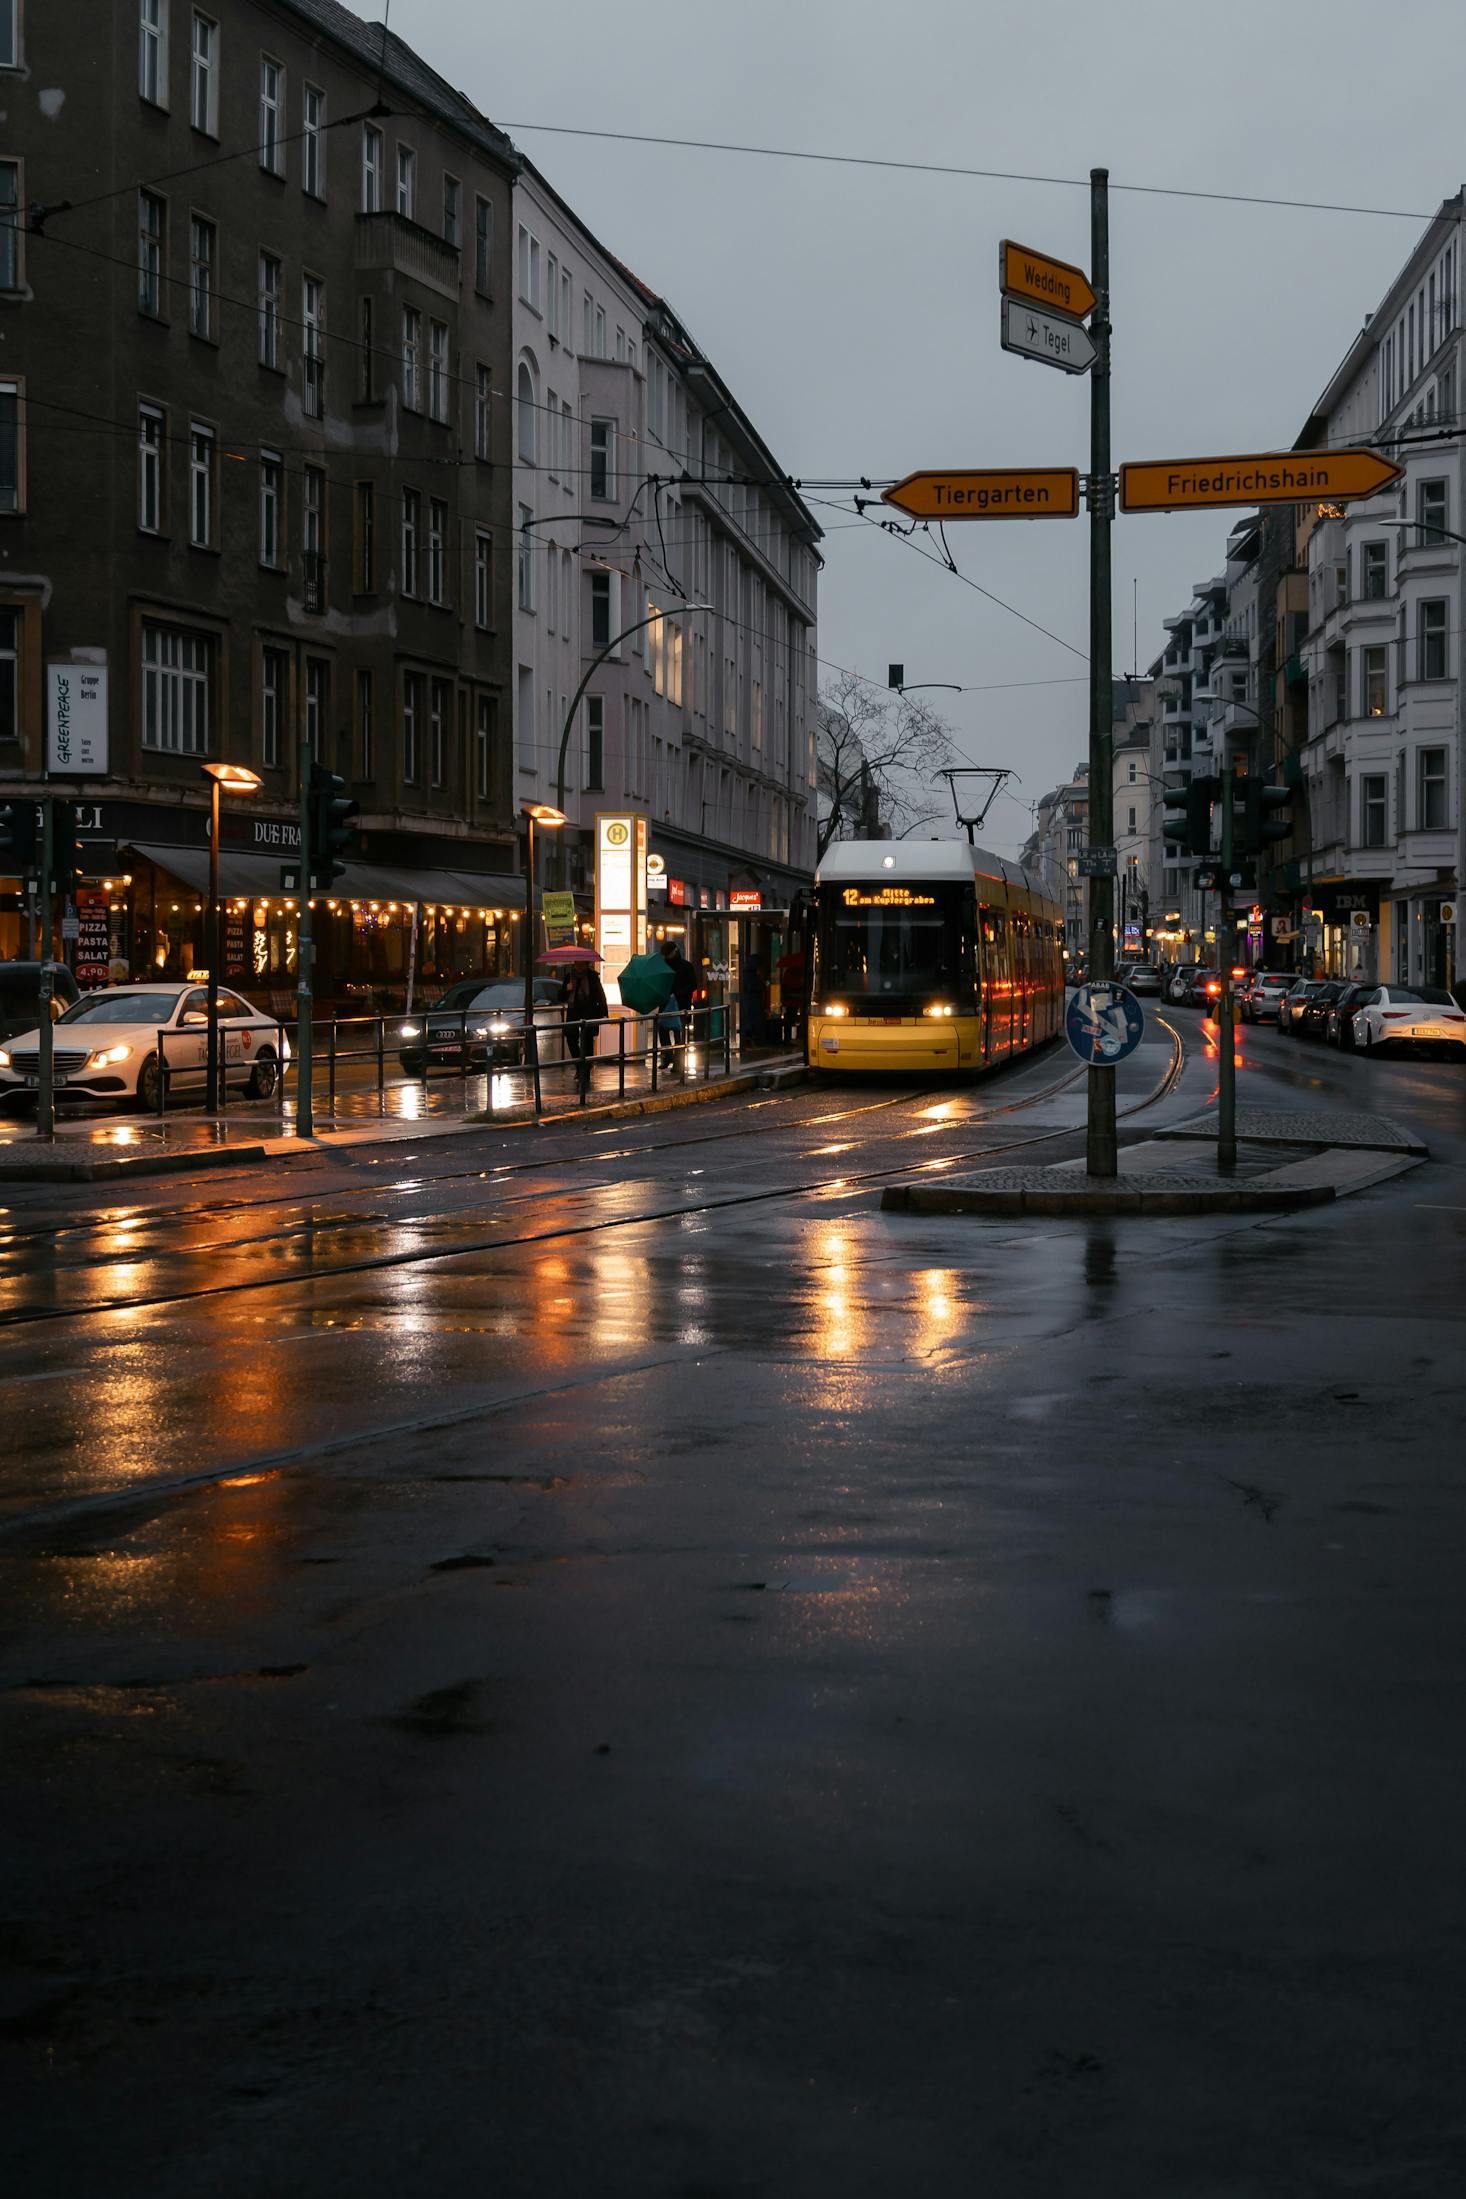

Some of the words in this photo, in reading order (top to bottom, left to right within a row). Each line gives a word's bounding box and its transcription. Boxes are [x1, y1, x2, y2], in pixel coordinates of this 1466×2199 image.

[1024, 263, 1071, 304] Wedding
[1043, 325, 1071, 355] Tegel
[1167, 467, 1329, 495] Friedrichshain
[933, 485, 1049, 509] Tiergarten
[81, 675, 100, 687] Gruppe
[81, 690, 97, 700] Berlin
[57, 674, 72, 765] GREENPEACE
[612, 827, 623, 841] H
[843, 888, 858, 906] 12
[882, 888, 910, 897] Mitte
[1335, 895, 1368, 909] IBM
[79, 922, 108, 933] PIZZA
[78, 937, 109, 947] PASTA
[78, 951, 109, 961] SALAT
